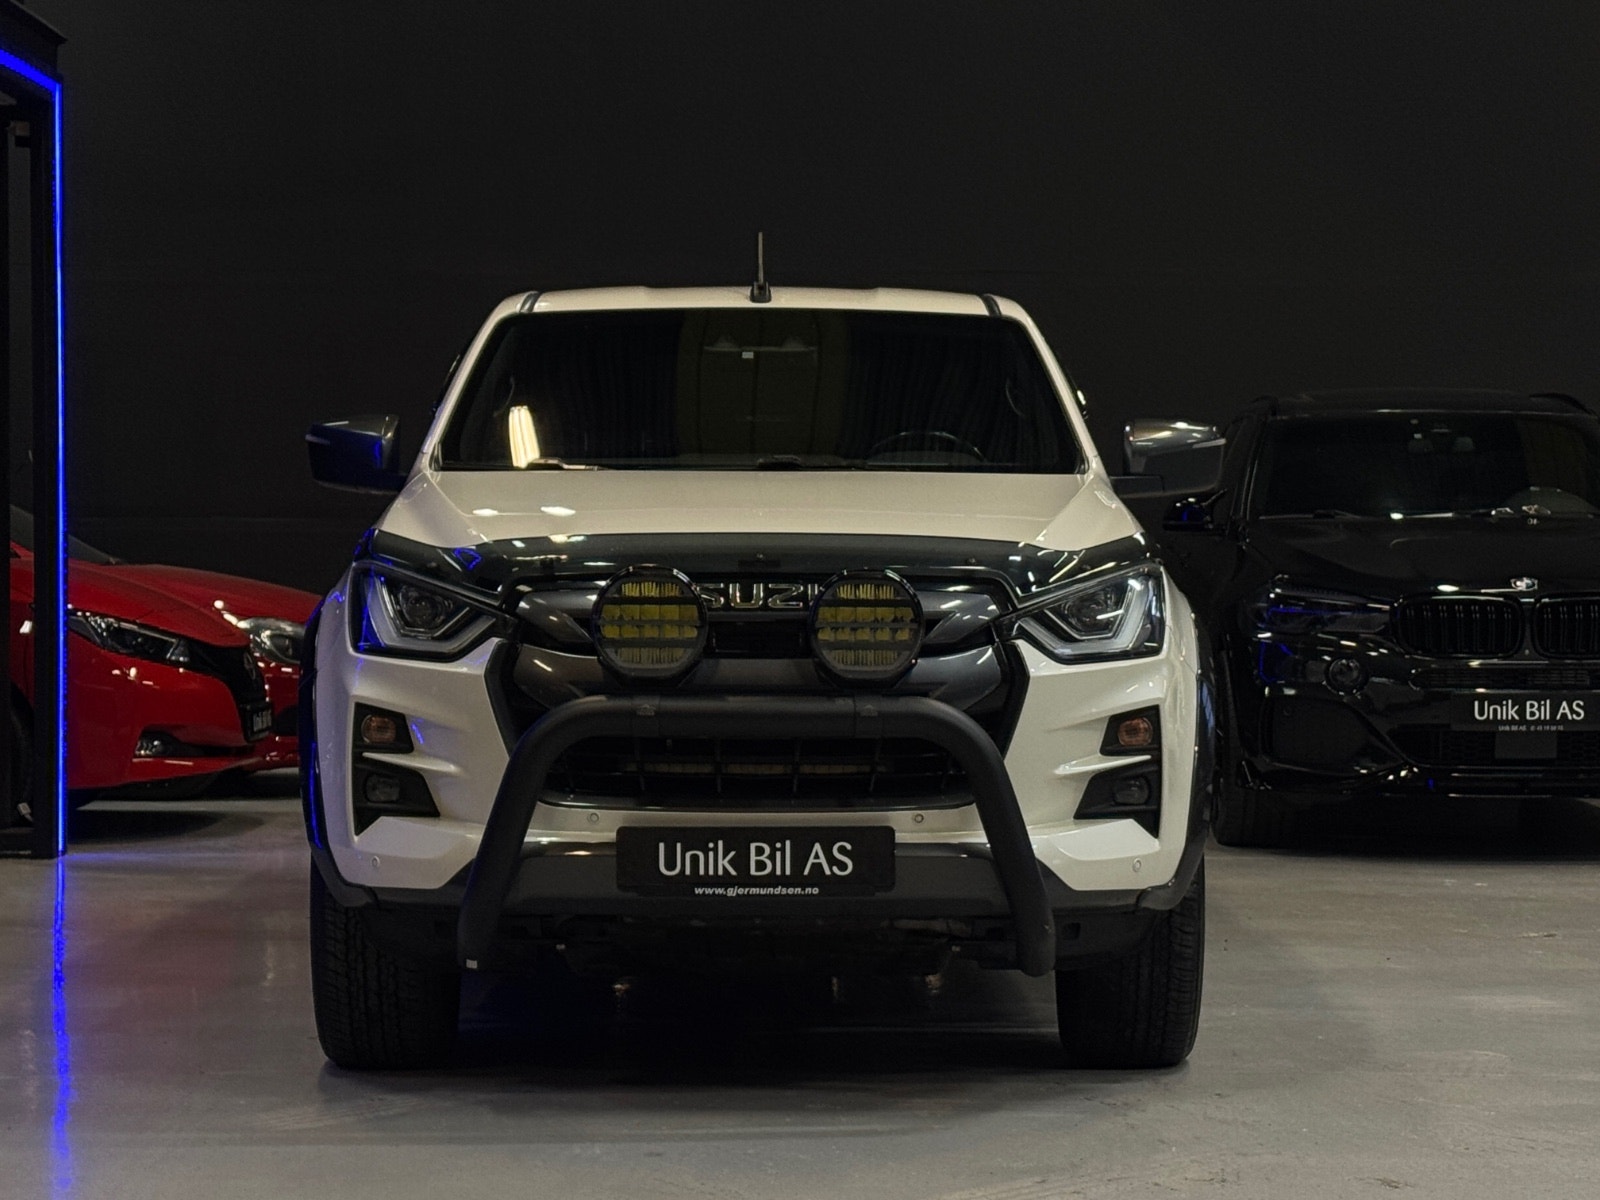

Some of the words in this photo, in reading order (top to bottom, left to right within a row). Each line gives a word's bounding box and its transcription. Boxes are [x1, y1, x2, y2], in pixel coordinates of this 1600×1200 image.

[693, 582, 819, 609] SUZ
[1473, 698, 1520, 721] Unik
[1525, 698, 1551, 721] Bil
[1555, 699, 1586, 721] AS
[657, 839, 738, 877] Unik
[748, 839, 791, 877] Bil
[802, 841, 854, 877] AS
[693, 885, 820, 897] www.gjermundsen.no
